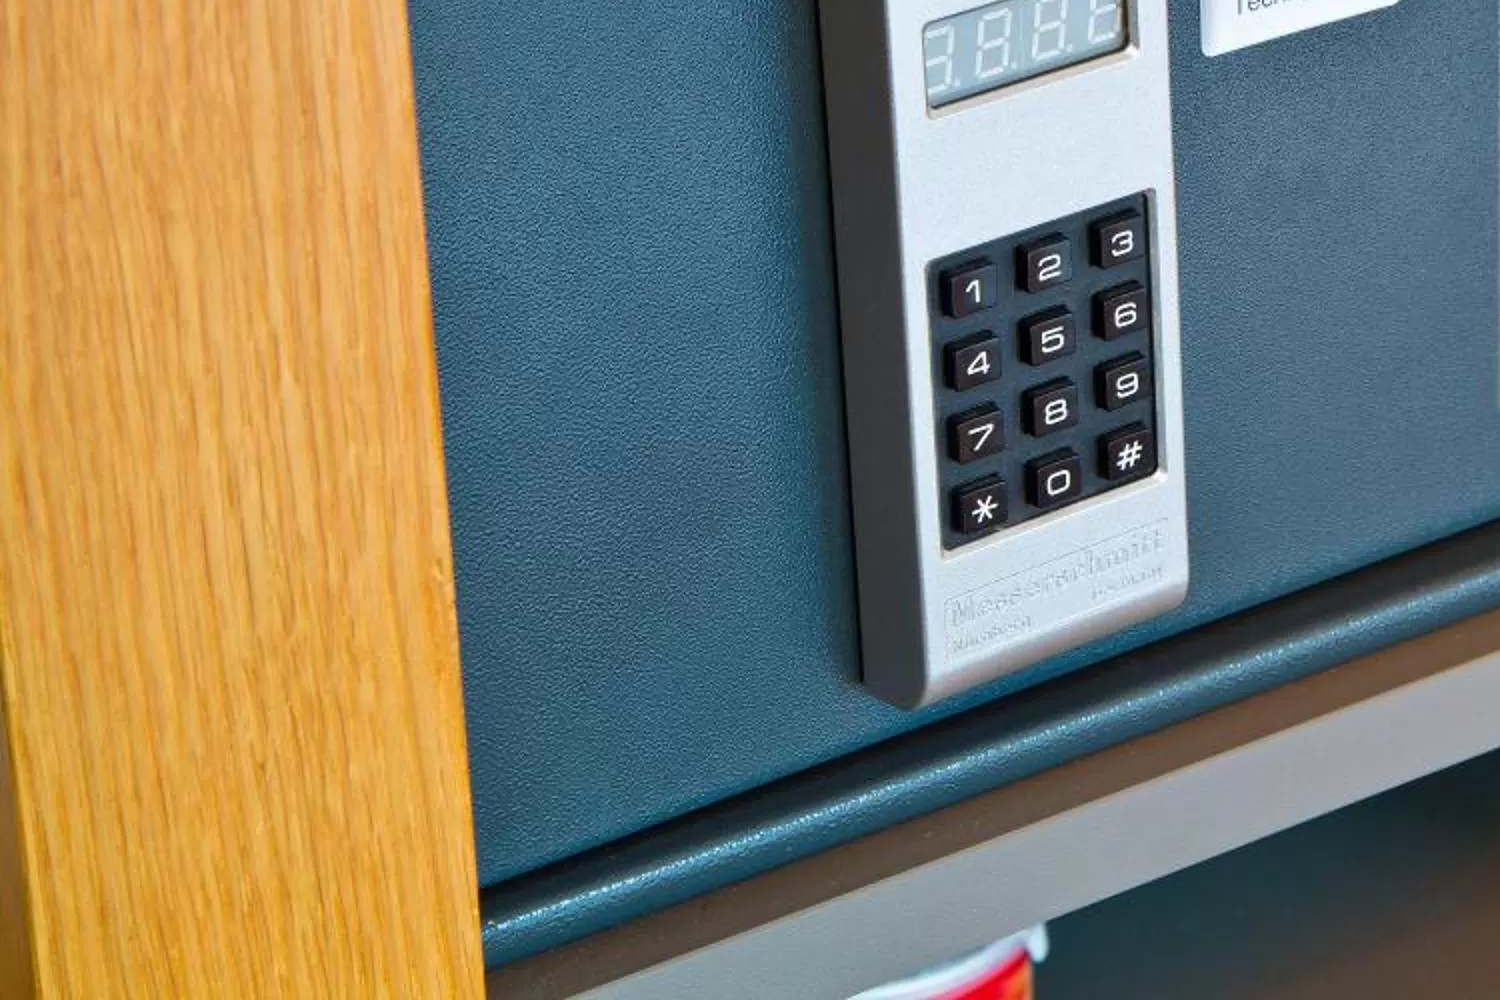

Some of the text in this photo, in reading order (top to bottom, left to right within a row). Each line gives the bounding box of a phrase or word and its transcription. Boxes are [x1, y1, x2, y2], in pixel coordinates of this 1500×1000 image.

[965, 230, 1135, 303] 1 2 3
[967, 302, 1138, 376] 4 5 6
[967, 372, 1140, 452] 7 8 9
